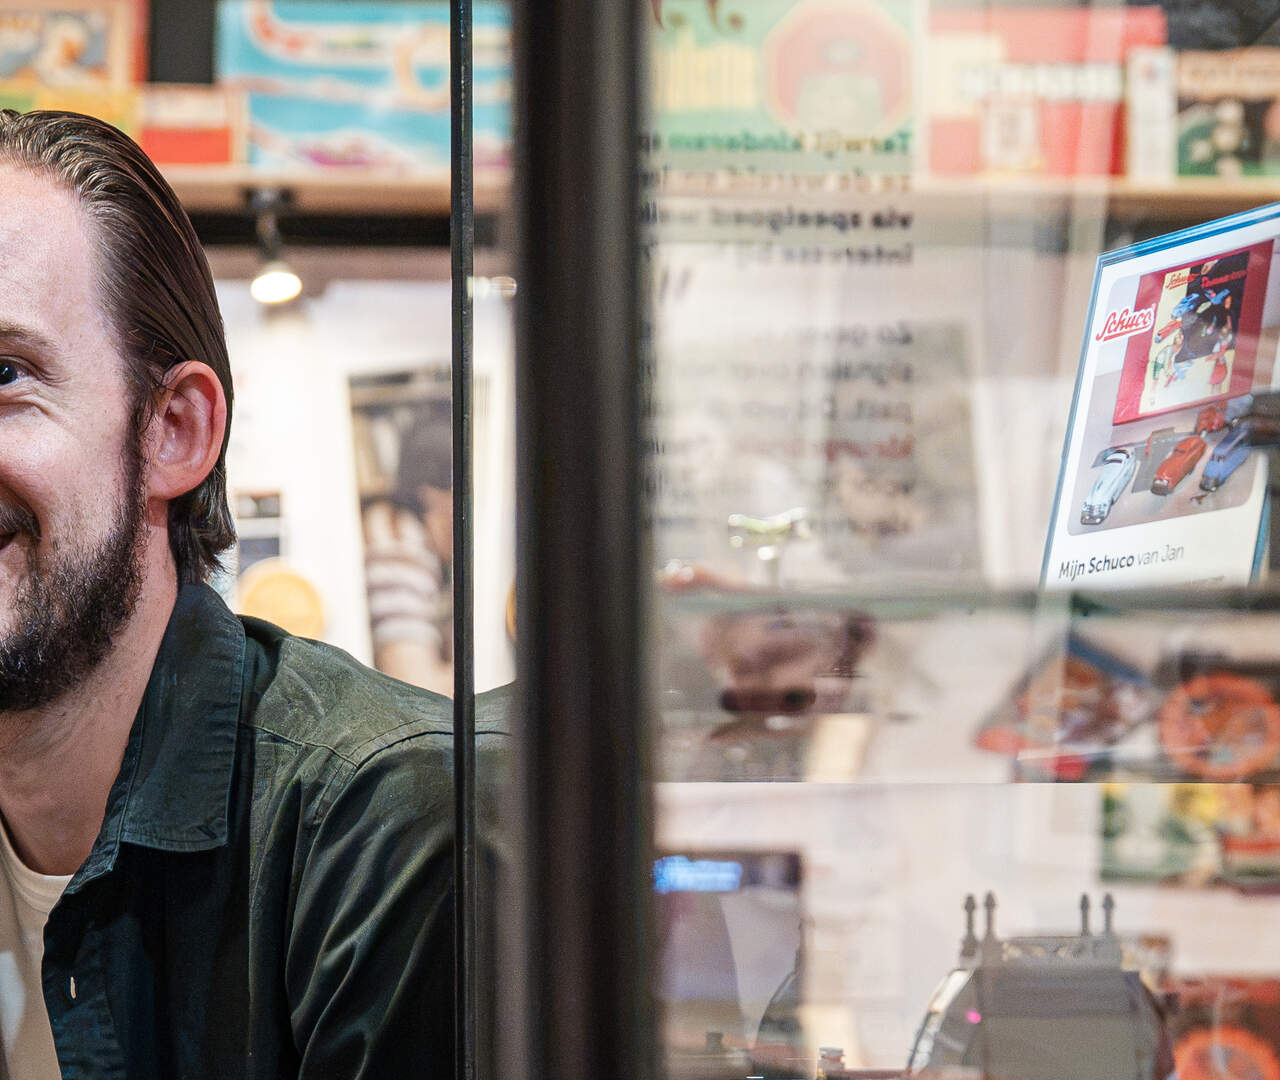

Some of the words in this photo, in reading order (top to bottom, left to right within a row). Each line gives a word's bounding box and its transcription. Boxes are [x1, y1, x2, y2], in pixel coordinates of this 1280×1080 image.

[1095, 306, 1155, 342] Schuco
[1058, 560, 1085, 582] Mijn
[1087, 554, 1136, 575] Schuco
[1136, 549, 1160, 566] van
[1160, 543, 1185, 563] Jan
